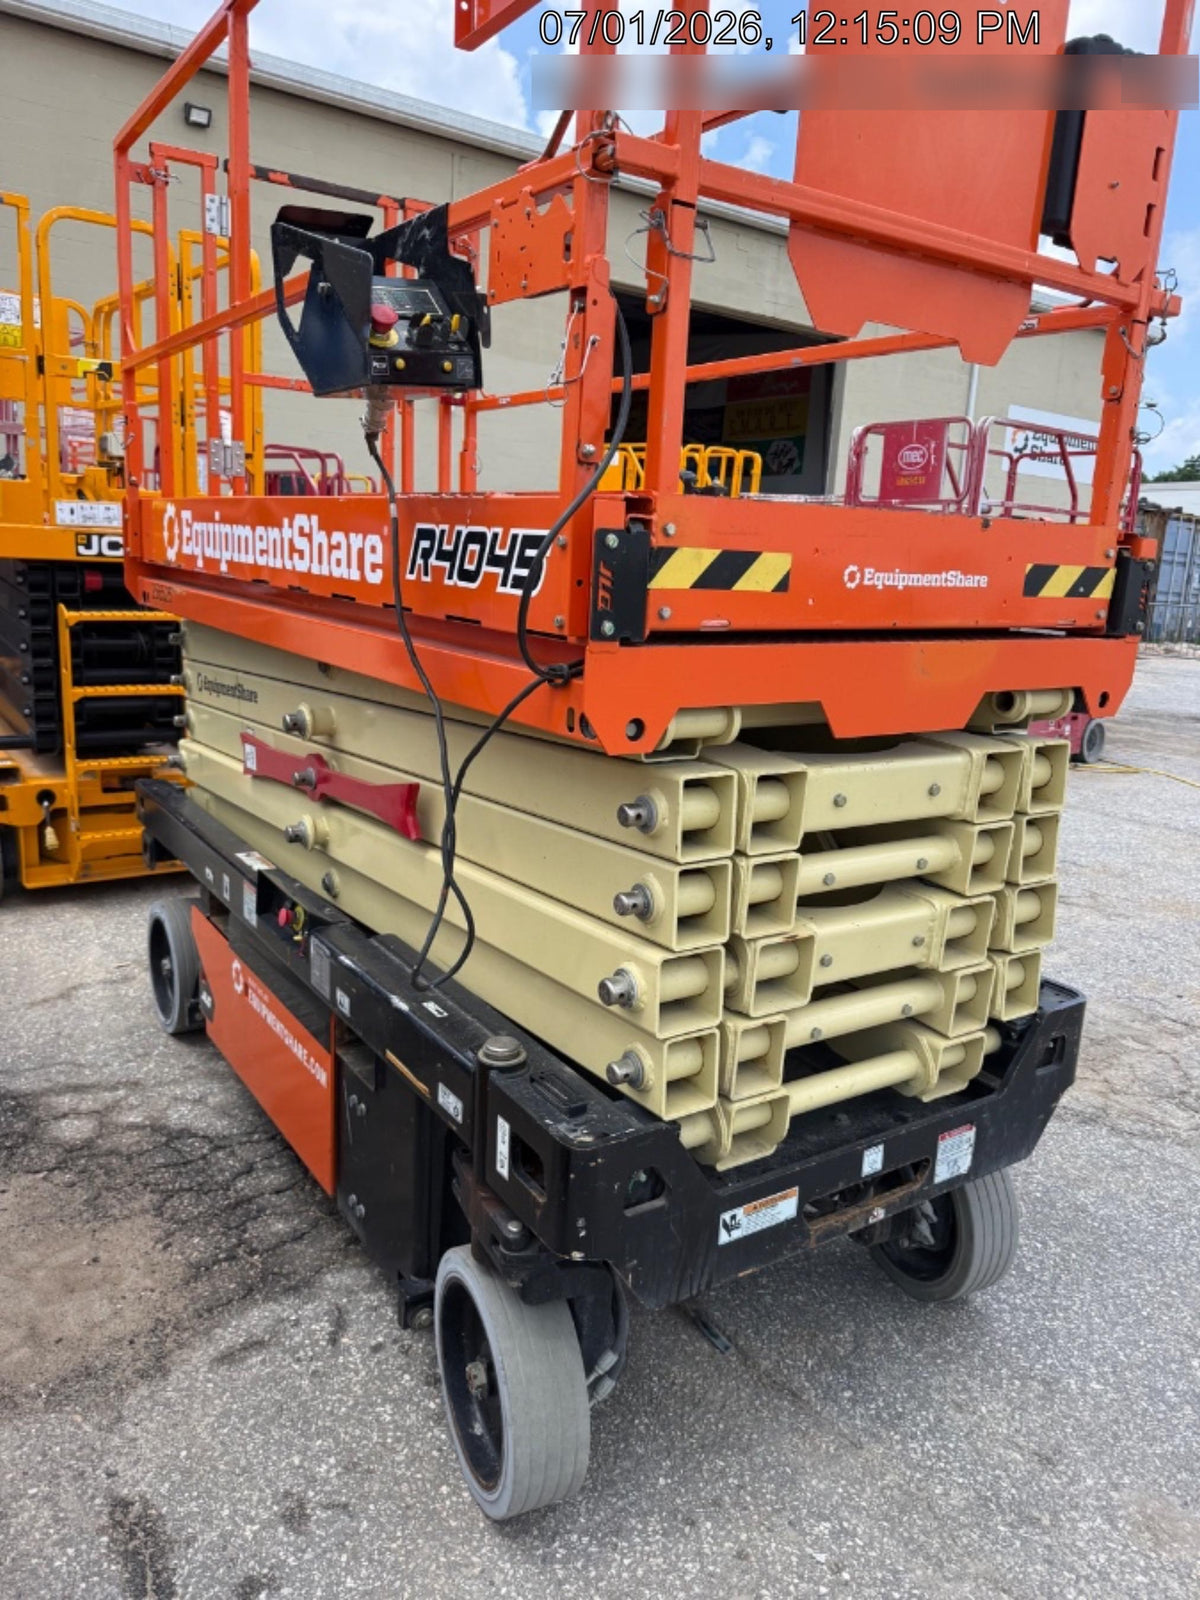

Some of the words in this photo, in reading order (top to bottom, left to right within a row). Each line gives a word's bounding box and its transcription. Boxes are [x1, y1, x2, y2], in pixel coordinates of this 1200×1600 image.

[180, 509, 384, 584] EquipmentShare
[405, 522, 553, 598] R4045
[862, 567, 988, 590] EquipmentShare
